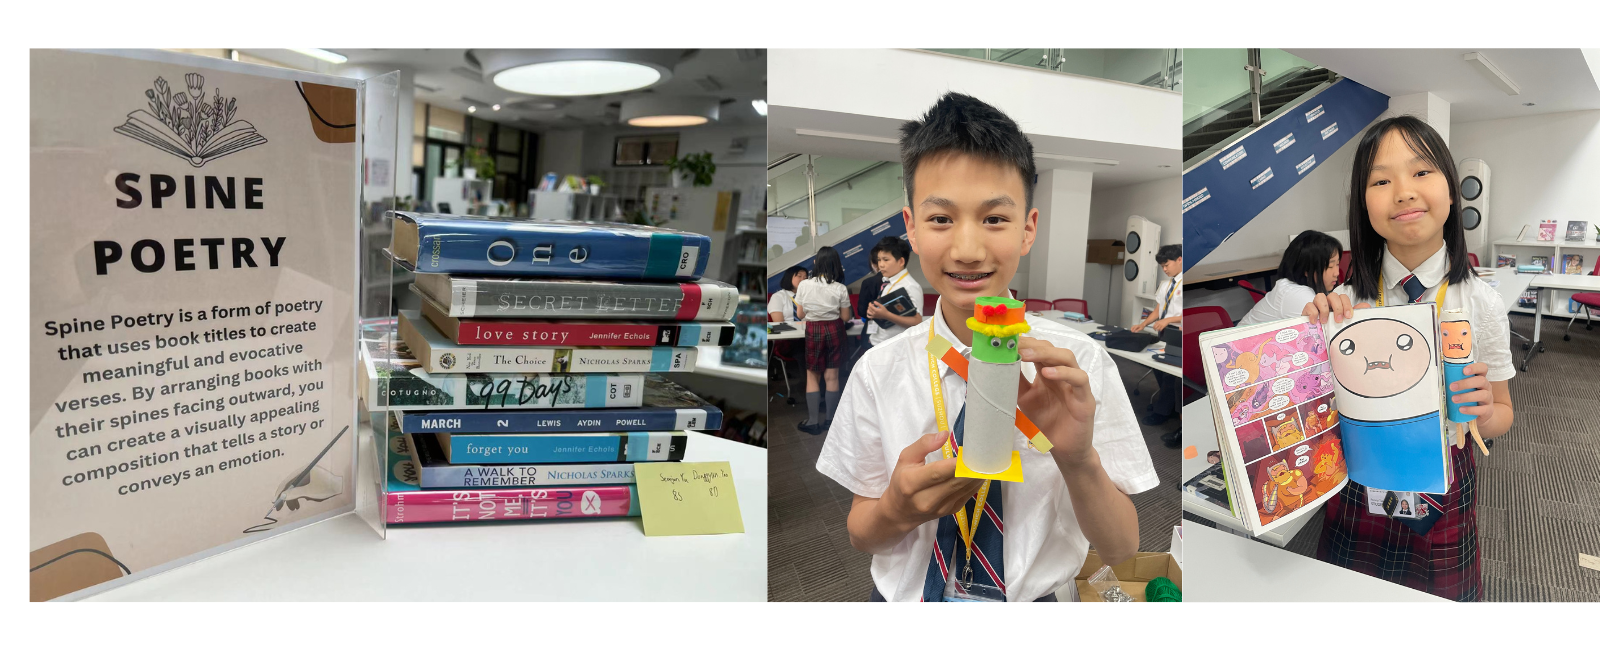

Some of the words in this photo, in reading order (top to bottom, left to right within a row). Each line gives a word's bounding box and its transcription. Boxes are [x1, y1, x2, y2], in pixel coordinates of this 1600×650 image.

[115, 172, 264, 210] SPINE
[94, 237, 287, 276] POETRY
[680, 252, 690, 270] CRO
[498, 293, 589, 313] SECRET
[45, 319, 105, 338] Spine
[111, 313, 174, 329] Poetry
[179, 309, 193, 322] is
[198, 310, 207, 320] a
[211, 306, 250, 319] form
[255, 301, 271, 315] of
[275, 300, 323, 316] poetry
[58, 344, 102, 360] that
[108, 340, 150, 354] uses
[156, 331, 199, 349] book
[203, 328, 246, 343] titles
[250, 327, 266, 337] to
[271, 321, 316, 335] create
[475, 325, 514, 340] love
[522, 328, 570, 344] story
[589, 332, 622, 340] Jennifer
[623, 332, 650, 340] Echols
[83, 356, 189, 383] meaningful
[194, 351, 224, 367] and
[229, 343, 303, 362] evocative
[493, 354, 512, 365] The
[515, 355, 547, 365] Choice
[579, 357, 620, 365] NICHOLAS
[621, 357, 651, 366] SPARKS
[673, 352, 682, 368] SPA
[55, 393, 126, 412] verses.
[133, 387, 155, 401] By
[161, 373, 240, 395] arranging
[245, 365, 289, 381] books
[293, 359, 322, 374] with
[381, 389, 437, 397] COTUGNO
[480, 378, 512, 410] 99
[516, 373, 573, 408] Days
[609, 383, 617, 399] COT
[55, 418, 105, 438] their
[110, 408, 169, 429] spines
[173, 397, 225, 416] facing
[229, 384, 295, 405] outward,
[299, 381, 323, 396] you
[67, 445, 101, 460] can
[107, 432, 165, 451] create
[171, 429, 180, 439] a
[184, 414, 246, 435] visually
[250, 400, 319, 424] appealing
[421, 418, 462, 429] MARCH
[496, 419, 509, 427] 2
[536, 419, 561, 427] LEWIS
[577, 419, 601, 427] AYDIN
[62, 451, 179, 486] composition
[184, 441, 218, 458] that
[222, 433, 254, 449] tells
[259, 432, 267, 441] a
[271, 423, 306, 438] story
[310, 419, 324, 429] or
[466, 443, 502, 457] forget
[507, 445, 529, 457] you
[552, 445, 586, 453] Jennifer
[588, 445, 615, 453] Echols
[118, 470, 190, 495] conveys
[195, 465, 214, 476] an
[219, 449, 284, 470] emotion.
[464, 468, 473, 477] A
[477, 467, 514, 477] WALK
[519, 467, 537, 476] TO
[464, 477, 536, 486] REMEMBER
[547, 470, 597, 480] NICHOLAS
[600, 470, 635, 479] SPARKS
[394, 494, 405, 523] Strohm
[452, 491, 471, 520] IT'S
[478, 492, 496, 520] NOT
[530, 489, 548, 518] IT'S
[555, 490, 573, 516] YOU
